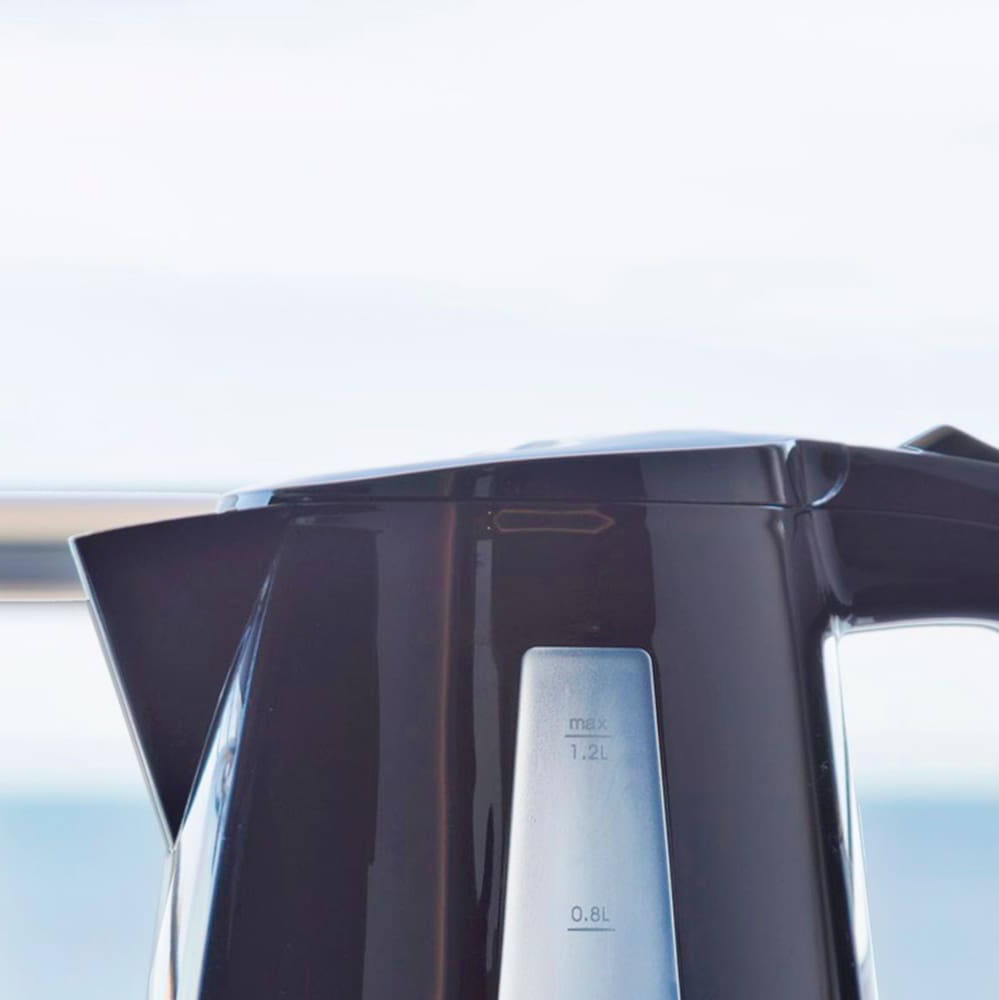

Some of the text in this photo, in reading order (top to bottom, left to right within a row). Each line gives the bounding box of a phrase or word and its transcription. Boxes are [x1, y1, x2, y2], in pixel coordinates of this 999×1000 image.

[568, 717, 609, 730] max
[570, 743, 609, 761] 1.2L
[570, 905, 611, 922] 0.8L
